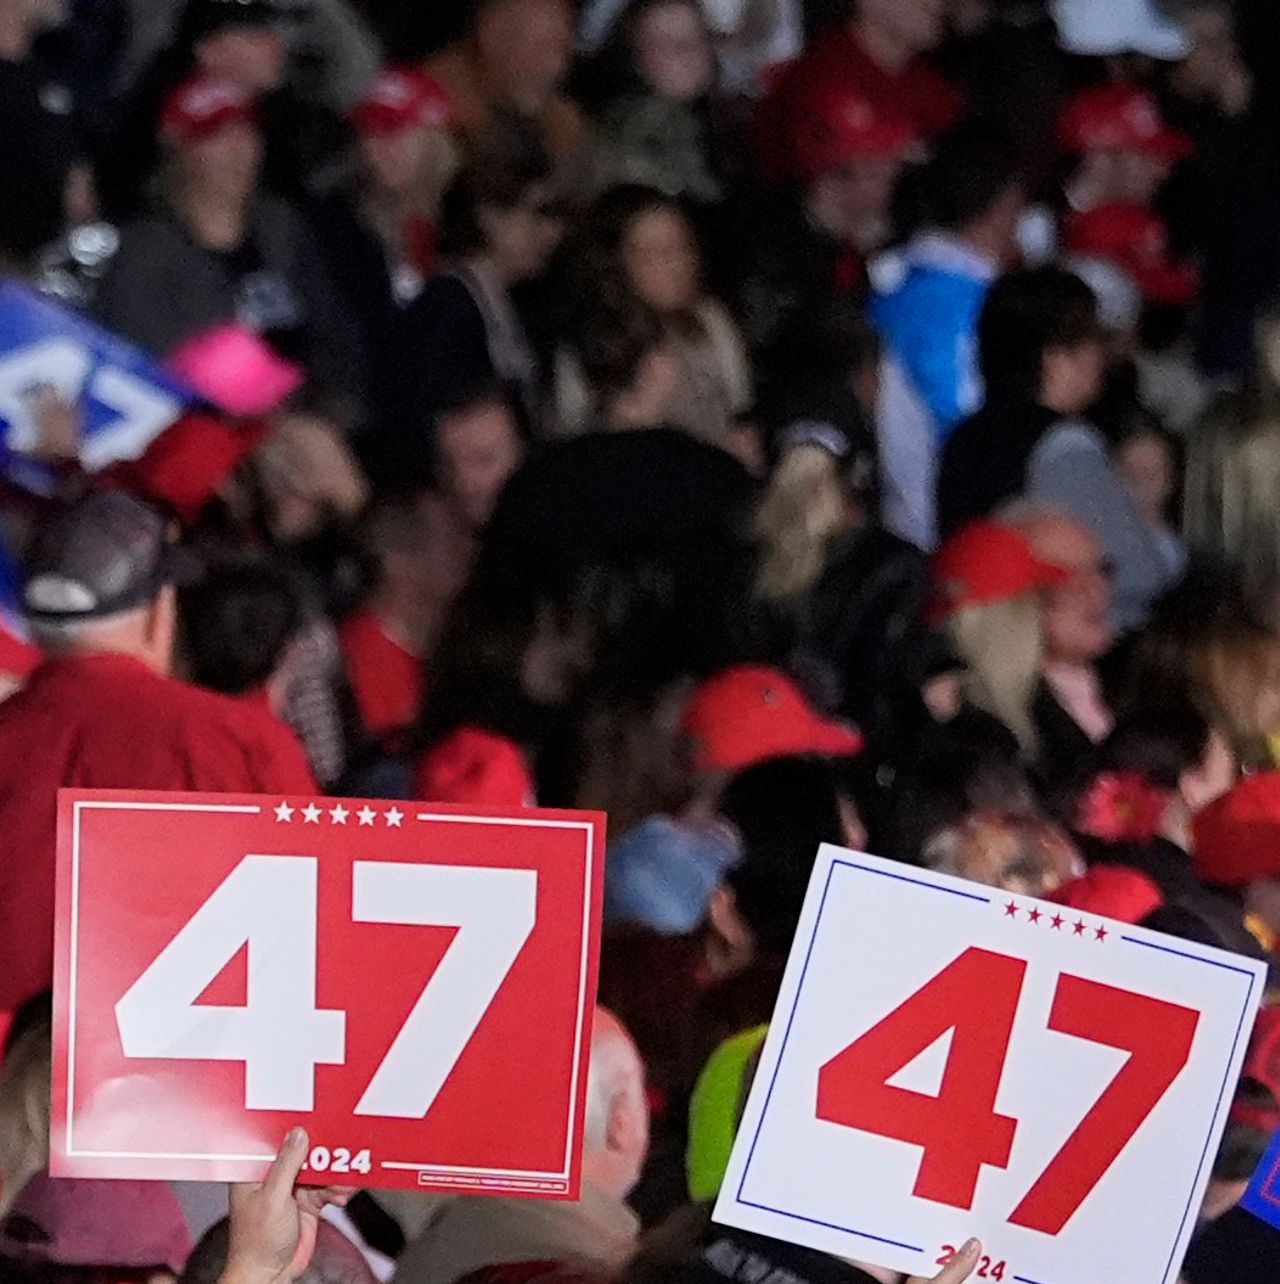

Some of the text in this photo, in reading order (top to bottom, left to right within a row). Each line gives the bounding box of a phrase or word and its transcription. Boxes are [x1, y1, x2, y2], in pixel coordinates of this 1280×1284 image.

[115, 854, 538, 1118] 47
[302, 1147, 371, 1174] 024
[815, 946, 1201, 1236] 47
[936, 1244, 1007, 1281] 224
